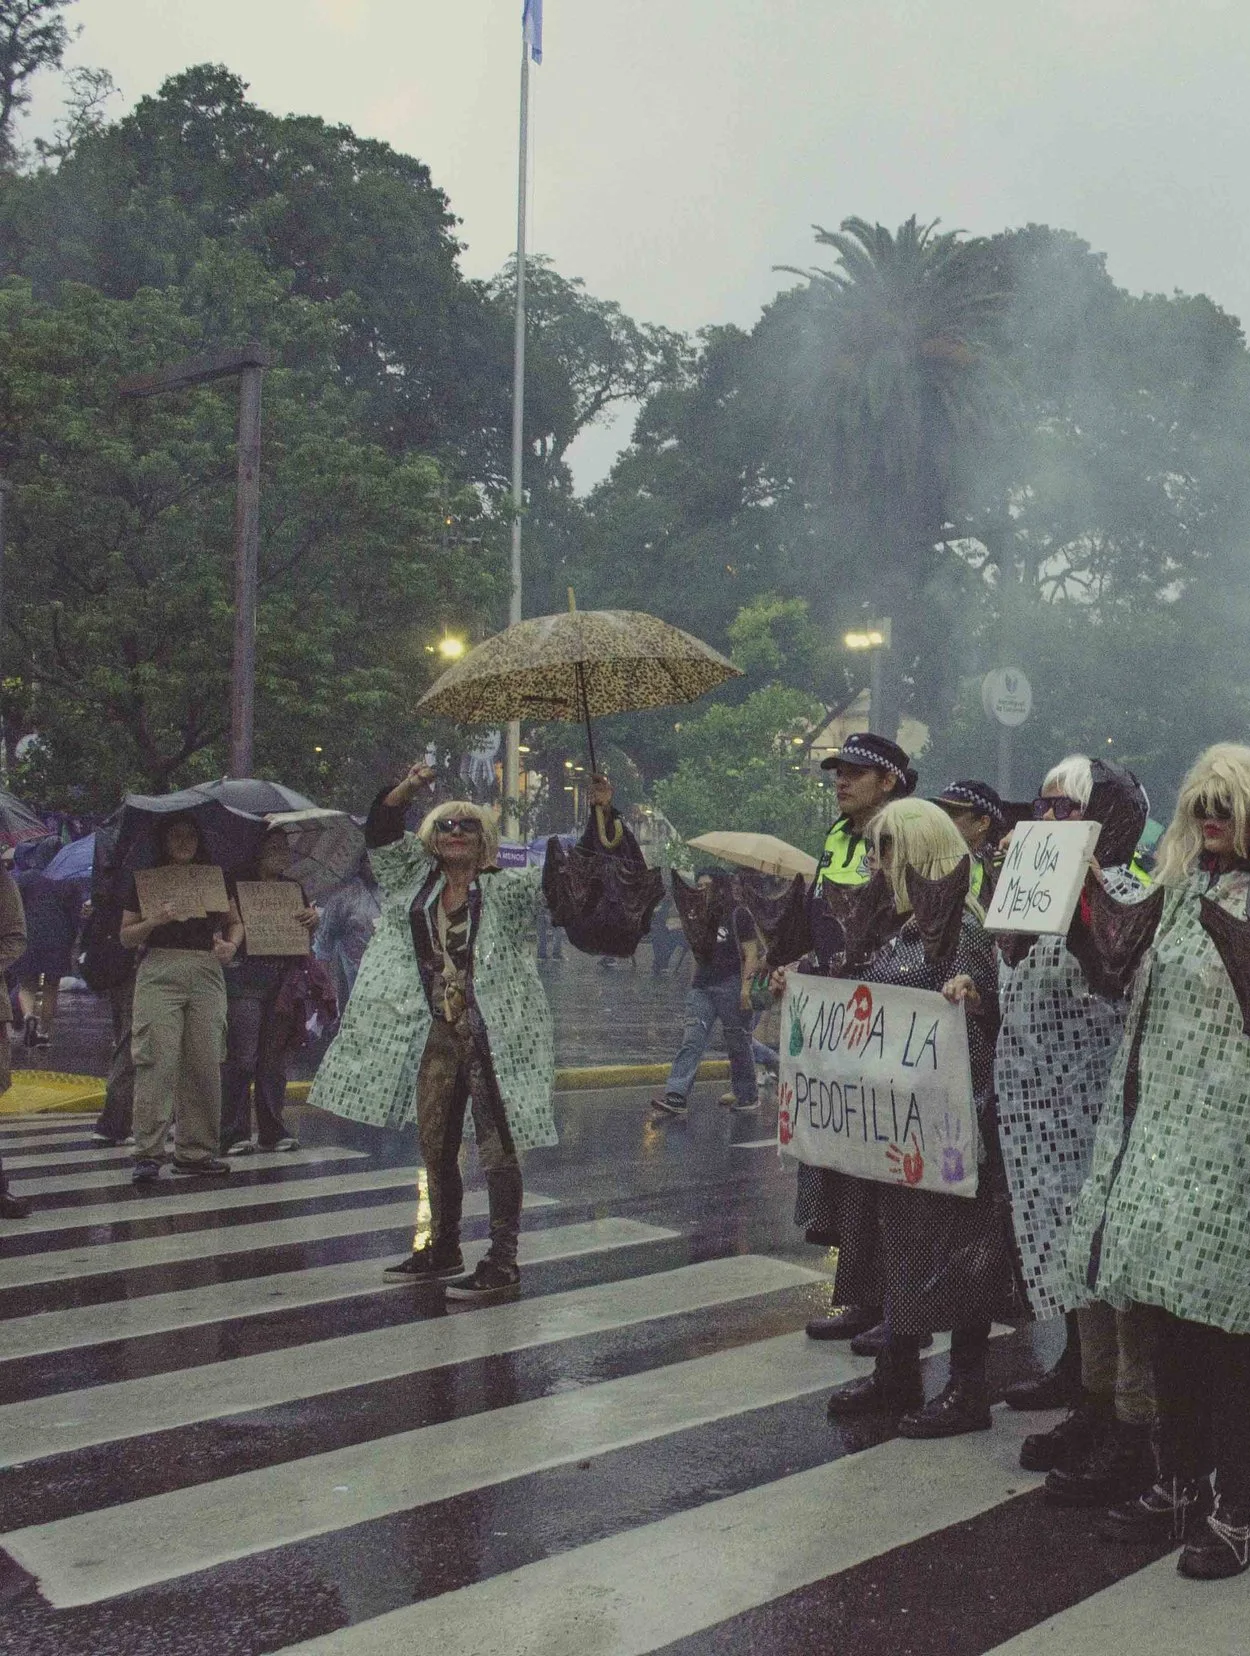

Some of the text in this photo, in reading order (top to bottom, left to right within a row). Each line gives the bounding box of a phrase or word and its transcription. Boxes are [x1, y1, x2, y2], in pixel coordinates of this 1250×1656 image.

[1006, 825, 1060, 877] NI UNA
[997, 876, 1052, 920] MENOS
[808, 1000, 940, 1070] NO A LA
[794, 1072, 926, 1152] PEDOFILIA
